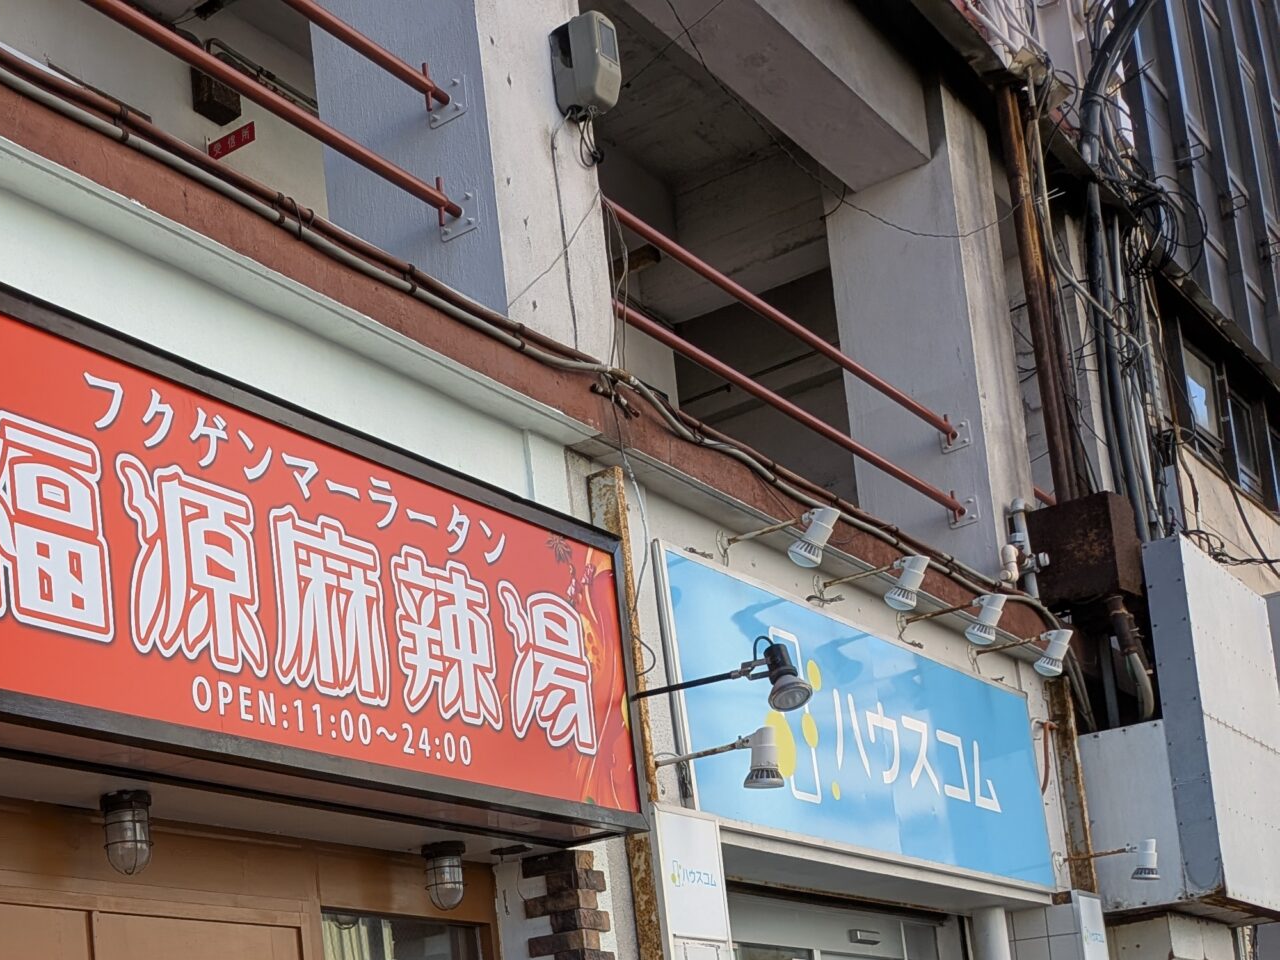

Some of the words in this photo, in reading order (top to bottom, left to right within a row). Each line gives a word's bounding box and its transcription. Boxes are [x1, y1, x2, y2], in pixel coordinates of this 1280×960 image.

[83, 372, 507, 564] フクゲンマーラータン
[831, 688, 1002, 813] ハウスコム
[682, 867, 717, 887] ハウスコム
